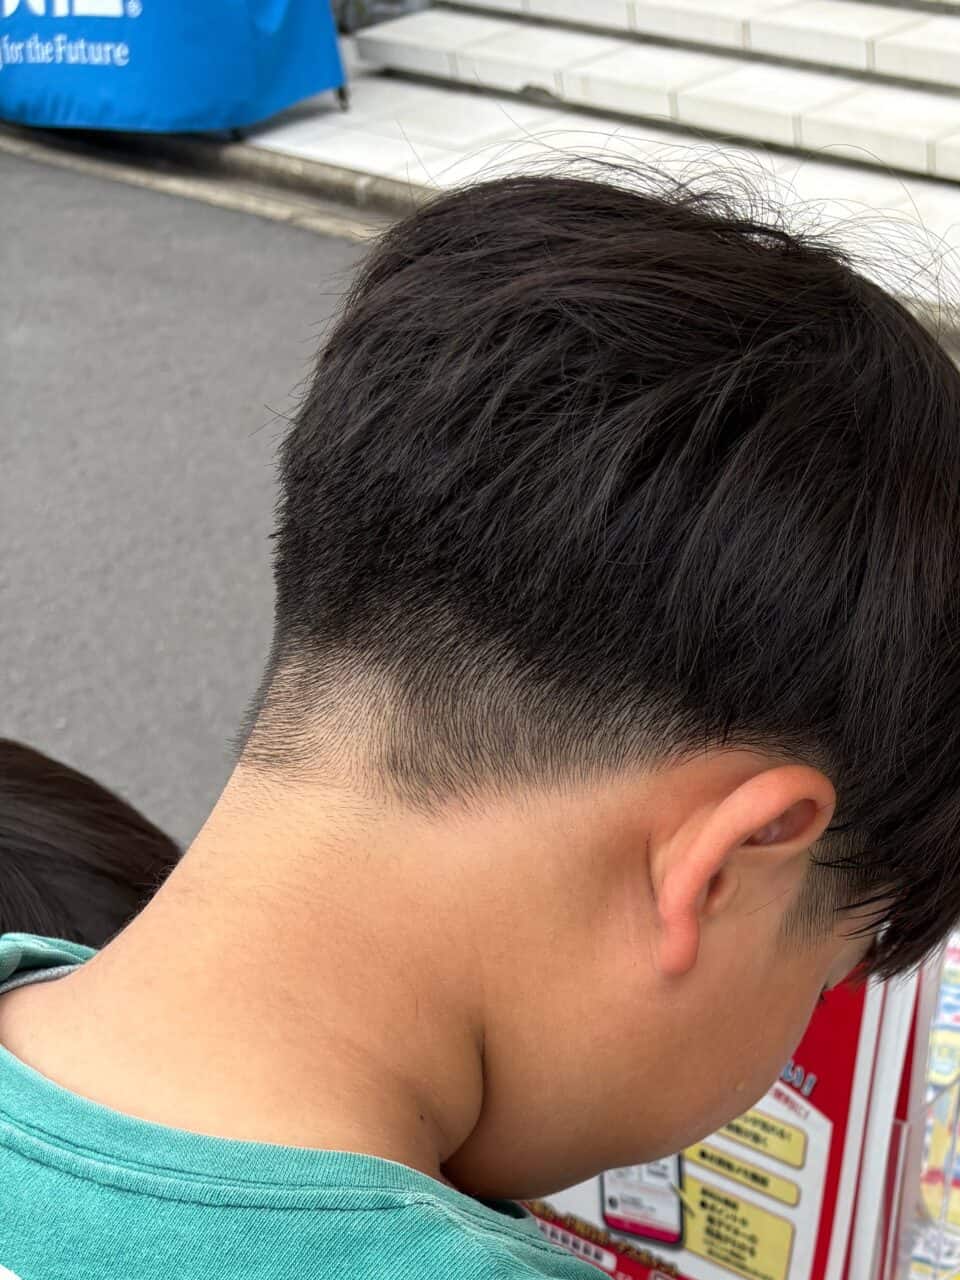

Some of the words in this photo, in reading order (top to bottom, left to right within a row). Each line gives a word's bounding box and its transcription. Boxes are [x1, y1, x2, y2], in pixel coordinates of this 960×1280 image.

[2, 33, 24, 64] for
[25, 33, 54, 64] the
[53, 33, 130, 66] Future
